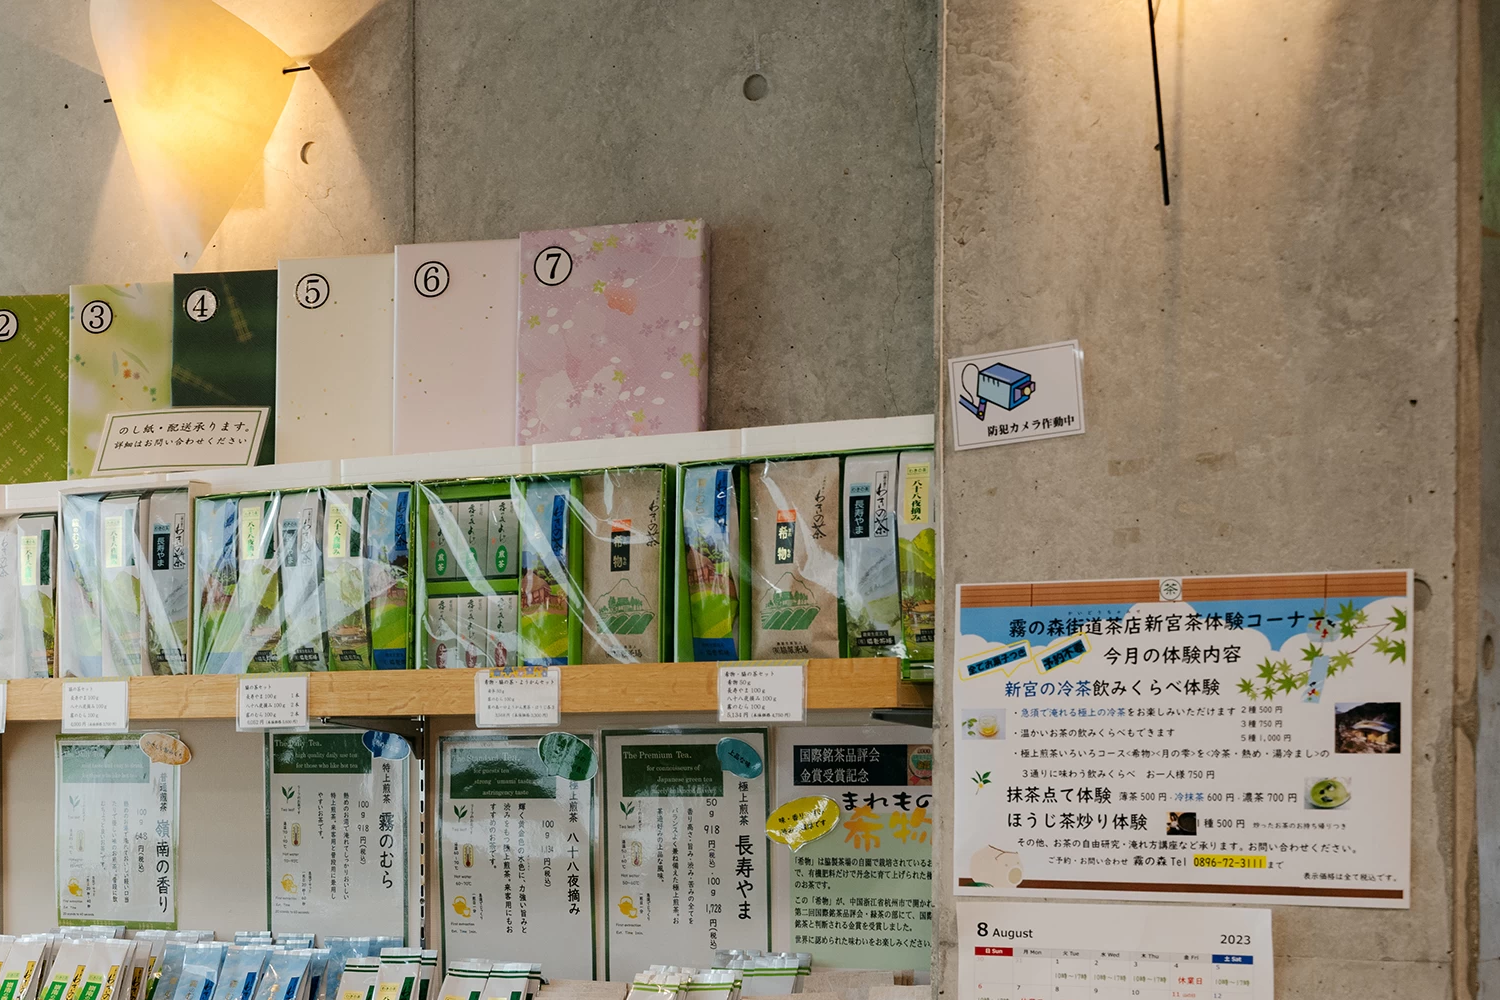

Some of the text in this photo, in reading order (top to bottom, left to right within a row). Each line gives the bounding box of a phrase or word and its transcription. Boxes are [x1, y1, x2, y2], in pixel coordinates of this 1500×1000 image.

[119, 422, 249, 435] のし紙・配送承ります。
[988, 415, 1074, 437] 防犯カメラ作動中
[114, 437, 248, 449] 詳細はお問い合わせください
[875, 483, 889, 535] わきの茶
[910, 480, 922, 521] 八十八夜摘み
[811, 490, 827, 540] わきの茶
[854, 499, 865, 535] 長寿やま
[247, 520, 256, 558] 八十八夜摘み
[777, 527, 788, 561] 希物
[156, 536, 165, 568] 長寿やま
[498, 550, 505, 568] 煎茶
[1164, 584, 1178, 595] 茶
[1009, 610, 1325, 638] 霧の森街道茶店新宮茶体験コーナー
[968, 648, 1028, 675] 全てお菓子つき
[1043, 640, 1086, 671] 予約不要
[1103, 645, 1242, 665] 今月の体験内容
[1004, 678, 1221, 697] 新宮の冷茶飲みくらべ体験
[309, 739, 322, 747] Tea.
[623, 751, 692, 759] The Premium Tea.
[800, 747, 880, 763] 国際銘茶品評会
[382, 763, 391, 804] 特上煎茶
[800, 768, 869, 783] 金賞受賞記念
[738, 781, 749, 826] 極上煎茶
[842, 791, 932, 811] まれもの
[1007, 786, 1112, 804] 抹茶点て体験
[843, 804, 932, 852] 希物
[1007, 812, 1148, 830] ほうじ茶炒り体験
[378, 812, 394, 889] 霧のむら
[156, 819, 171, 913] 嶺南の香り
[567, 832, 580, 916] 八十八夜摘み
[1049, 856, 1285, 870] ご予約・お問い合わせ 霧の森 Tel 0896-72-3111 まで
[735, 835, 754, 920] 長寿やま
[795, 881, 831, 890] のお茶です。
[1304, 872, 1398, 883] 表示価格は全て税込です。
[977, 922, 1251, 945] 8 August 2023
[1178, 977, 1203, 985] 休業日
